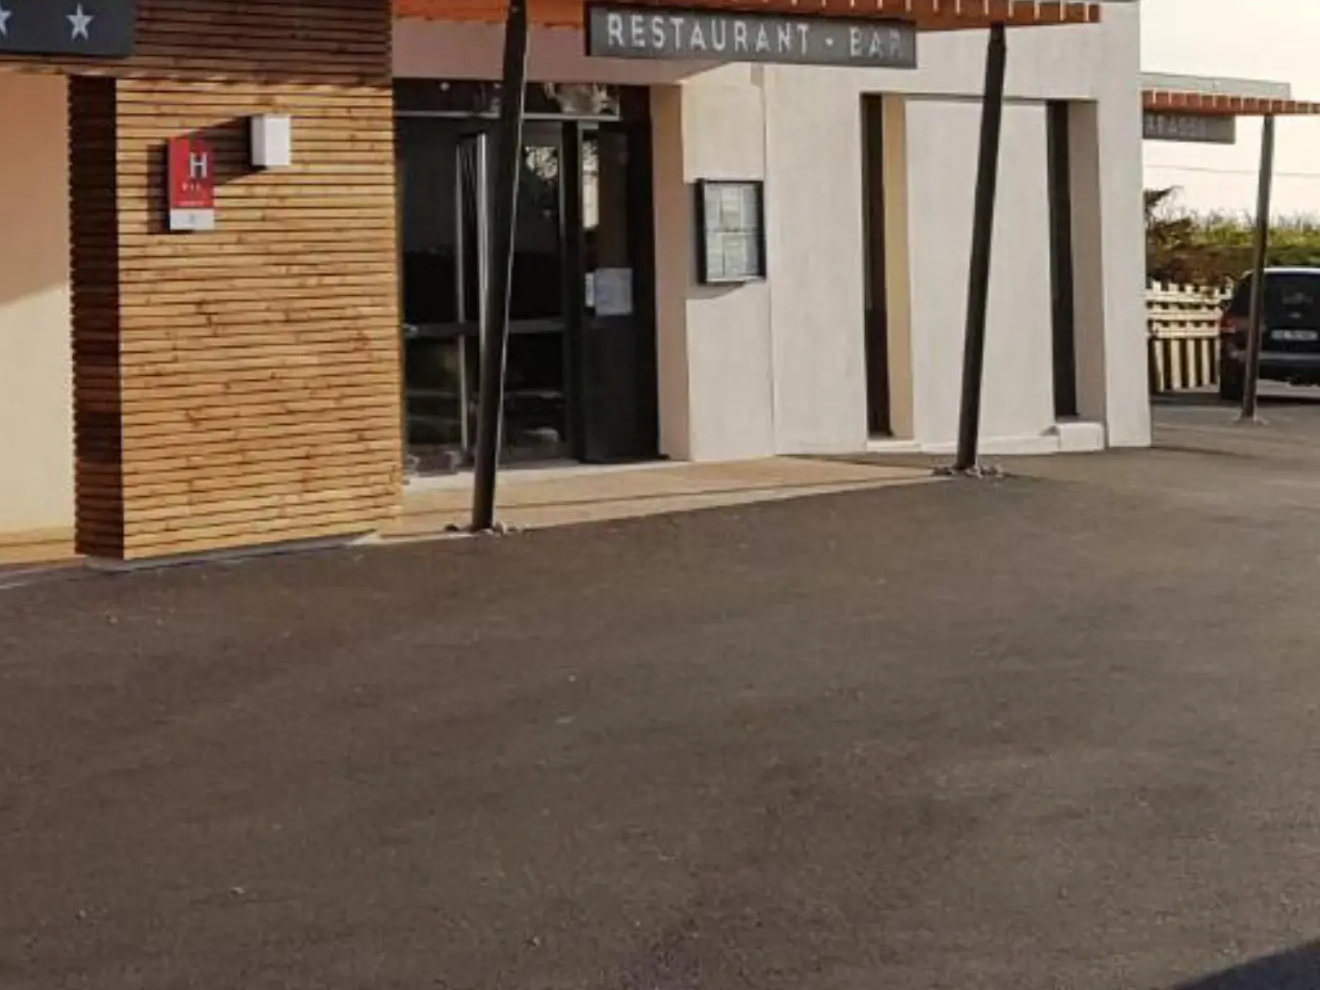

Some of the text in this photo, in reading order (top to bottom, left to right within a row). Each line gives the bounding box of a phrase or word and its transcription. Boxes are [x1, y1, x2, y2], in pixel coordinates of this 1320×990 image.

[606, 13, 904, 59] RESTAURANT BAR
[189, 152, 208, 179] H
